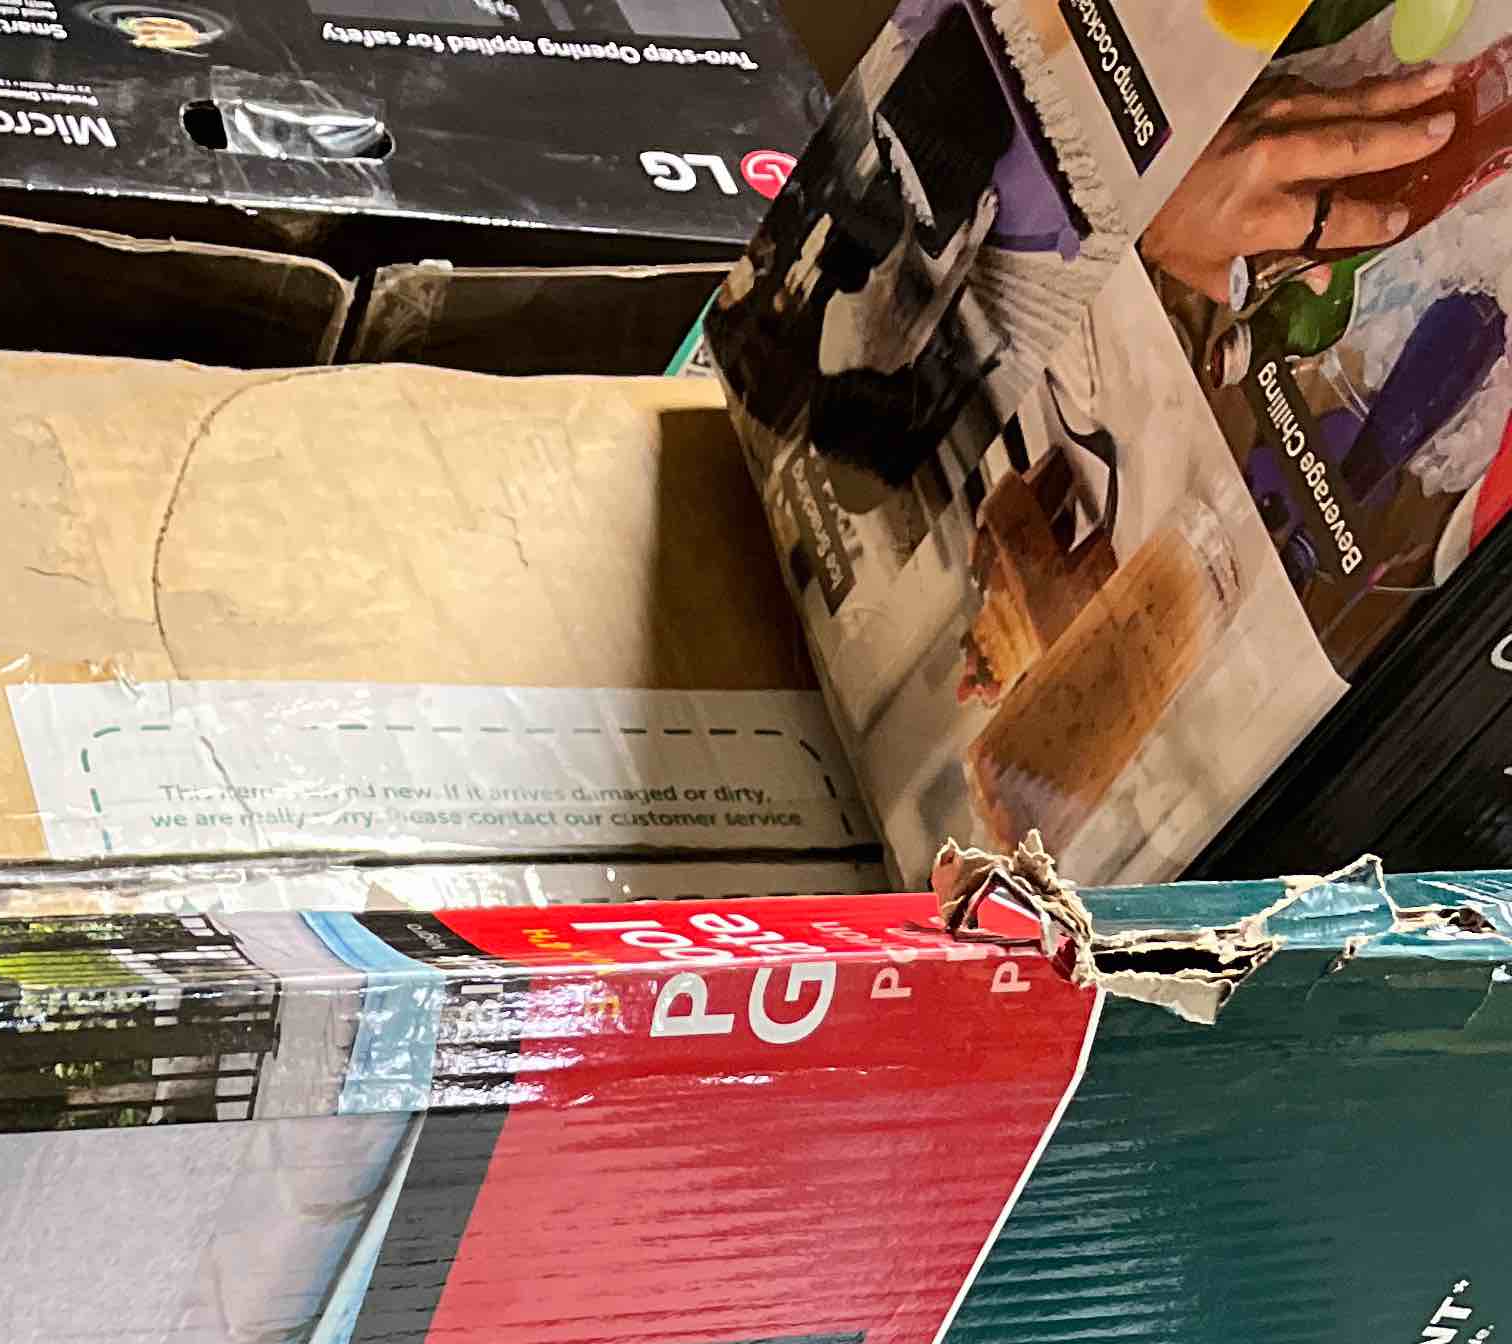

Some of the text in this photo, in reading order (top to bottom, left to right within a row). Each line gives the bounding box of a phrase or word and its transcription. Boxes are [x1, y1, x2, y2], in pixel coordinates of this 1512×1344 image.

[321, 22, 759, 72] Two-step Opening applied for safety
[1114, 65, 1154, 146] Shrimp
[640, 149, 739, 196] LG
[1257, 361, 1363, 575] Beverage Chilling
[683, 786, 707, 801] or
[713, 783, 773, 806] dirty,
